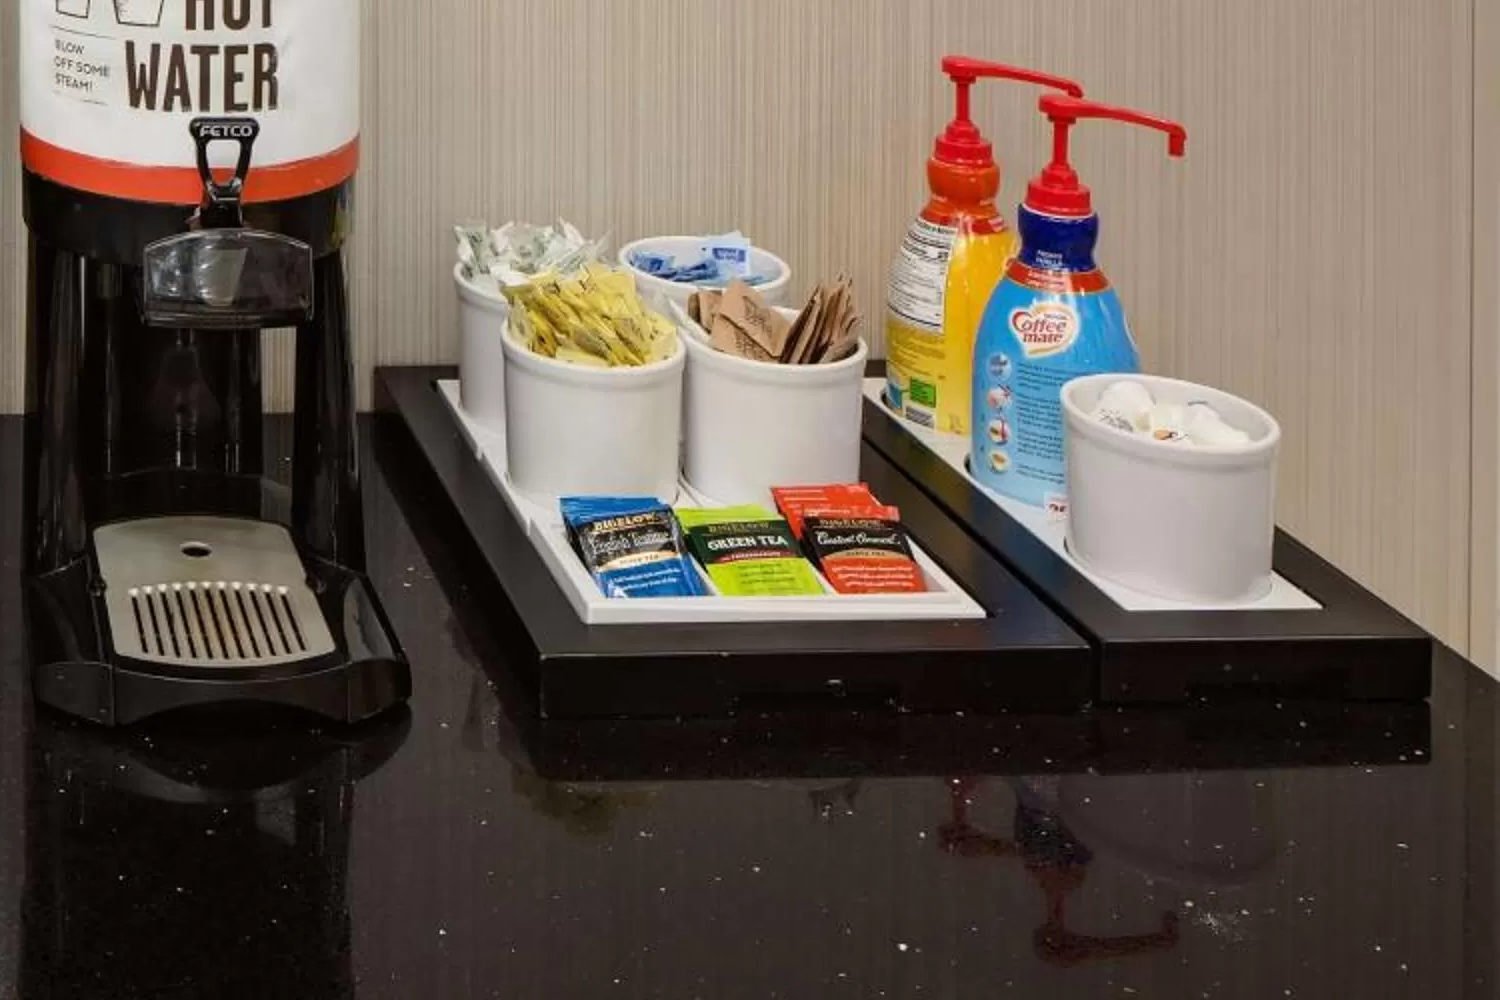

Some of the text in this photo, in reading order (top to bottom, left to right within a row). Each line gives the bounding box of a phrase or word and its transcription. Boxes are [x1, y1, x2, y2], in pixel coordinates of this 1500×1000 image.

[54, 55, 111, 78] OFF SOME
[125, 39, 279, 113] WATER
[199, 124, 254, 138] FETCO
[1022, 332, 1064, 344] mate
[707, 534, 789, 551] GREEN TEA
